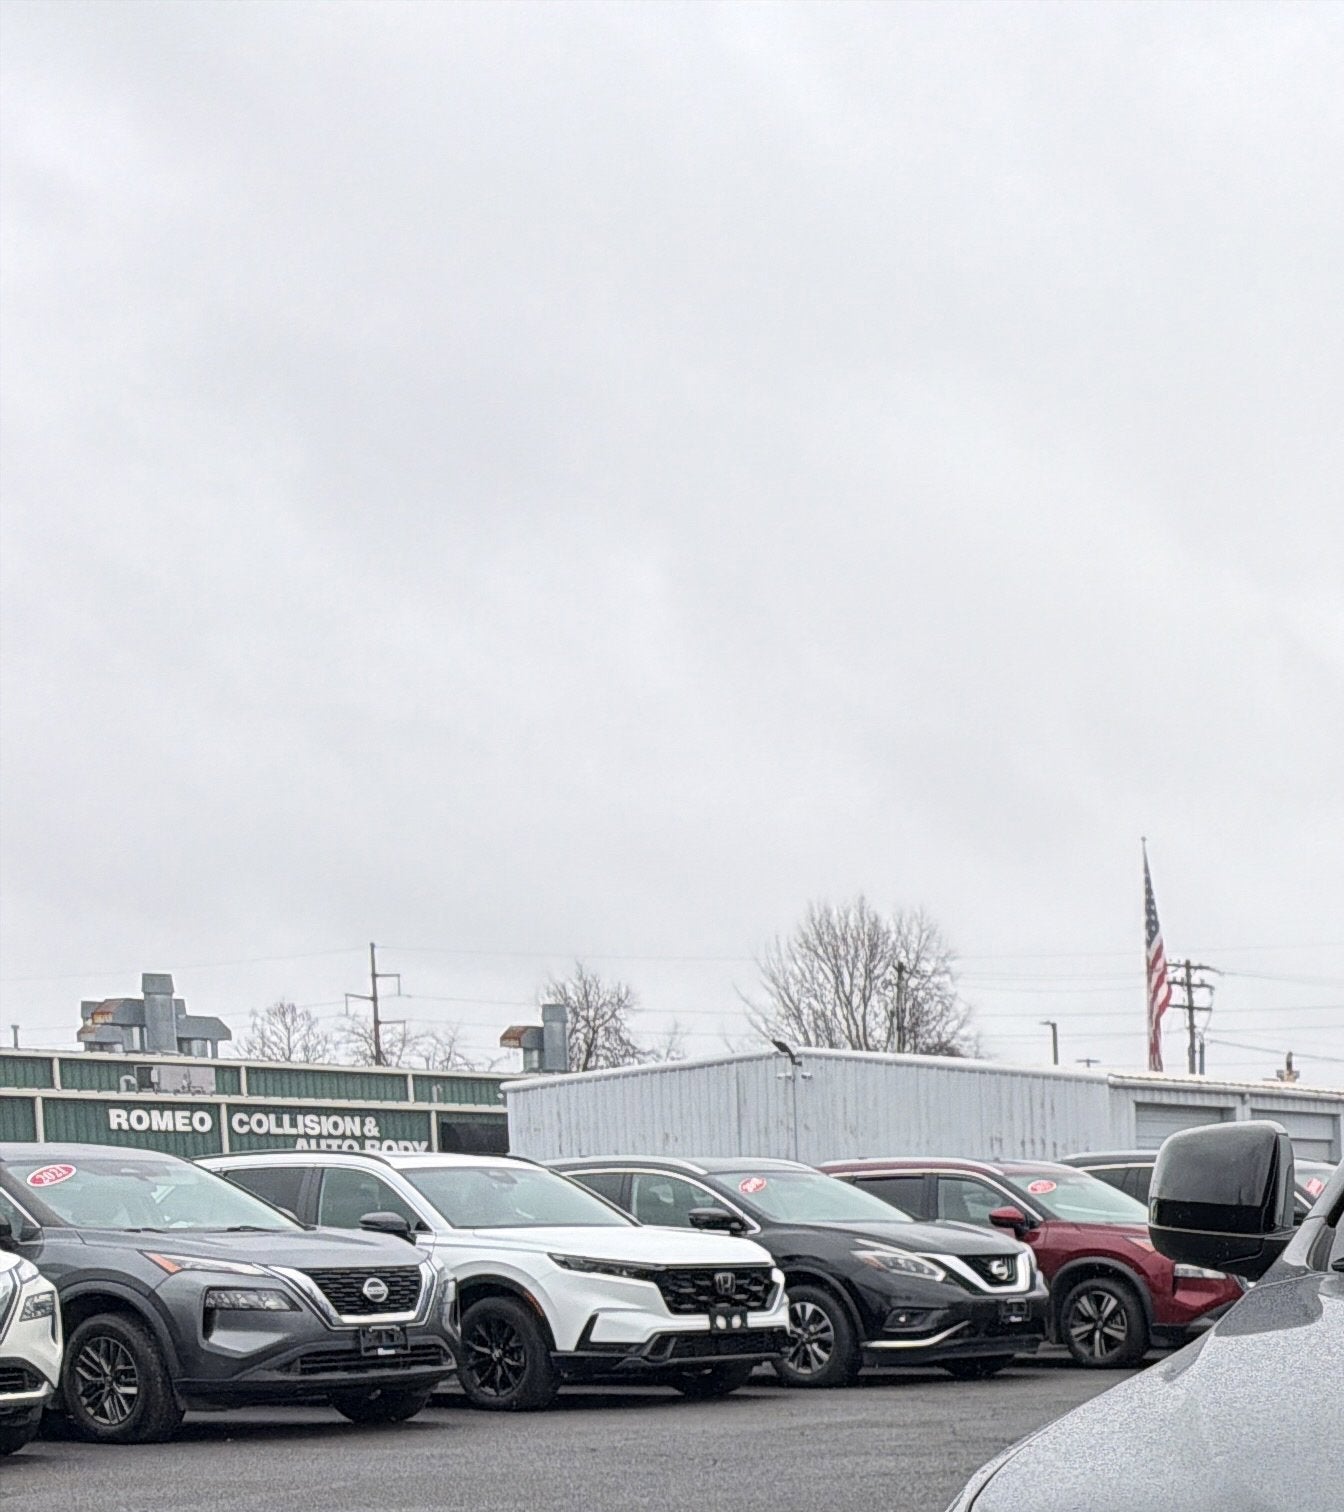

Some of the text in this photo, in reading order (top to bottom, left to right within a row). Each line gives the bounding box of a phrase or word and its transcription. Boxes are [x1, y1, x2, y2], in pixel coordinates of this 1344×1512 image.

[108, 1108, 213, 1133] ROMEO
[231, 1112, 360, 1137] COLLISION
[295, 1137, 360, 1151] AUTO
